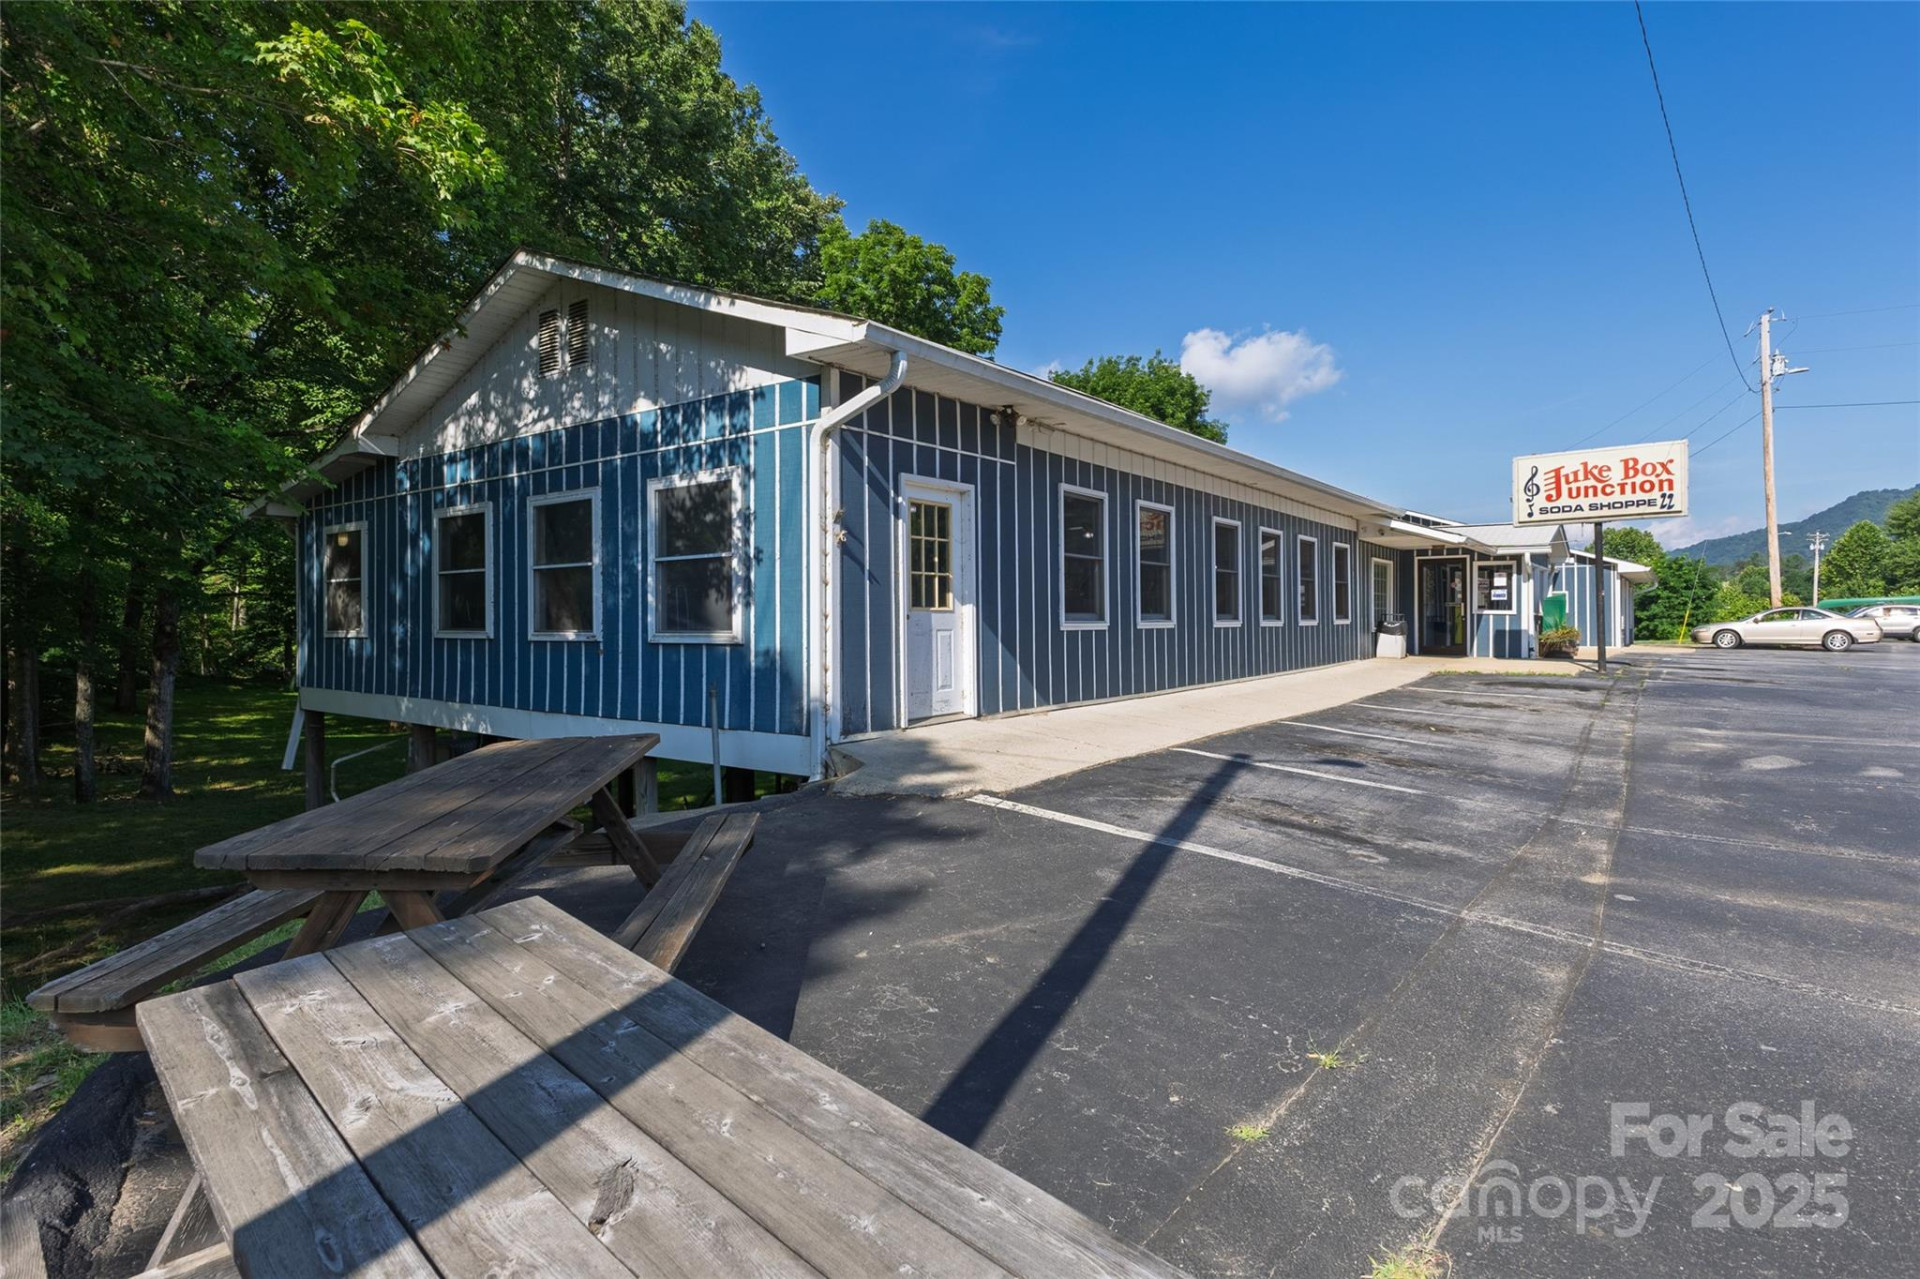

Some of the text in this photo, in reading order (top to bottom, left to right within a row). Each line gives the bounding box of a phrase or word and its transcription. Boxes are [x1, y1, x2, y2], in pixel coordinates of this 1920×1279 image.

[1544, 457, 1675, 503] Juke Box
[1539, 504, 1585, 515] SODA
[1588, 498, 1658, 511] SHOPPE
